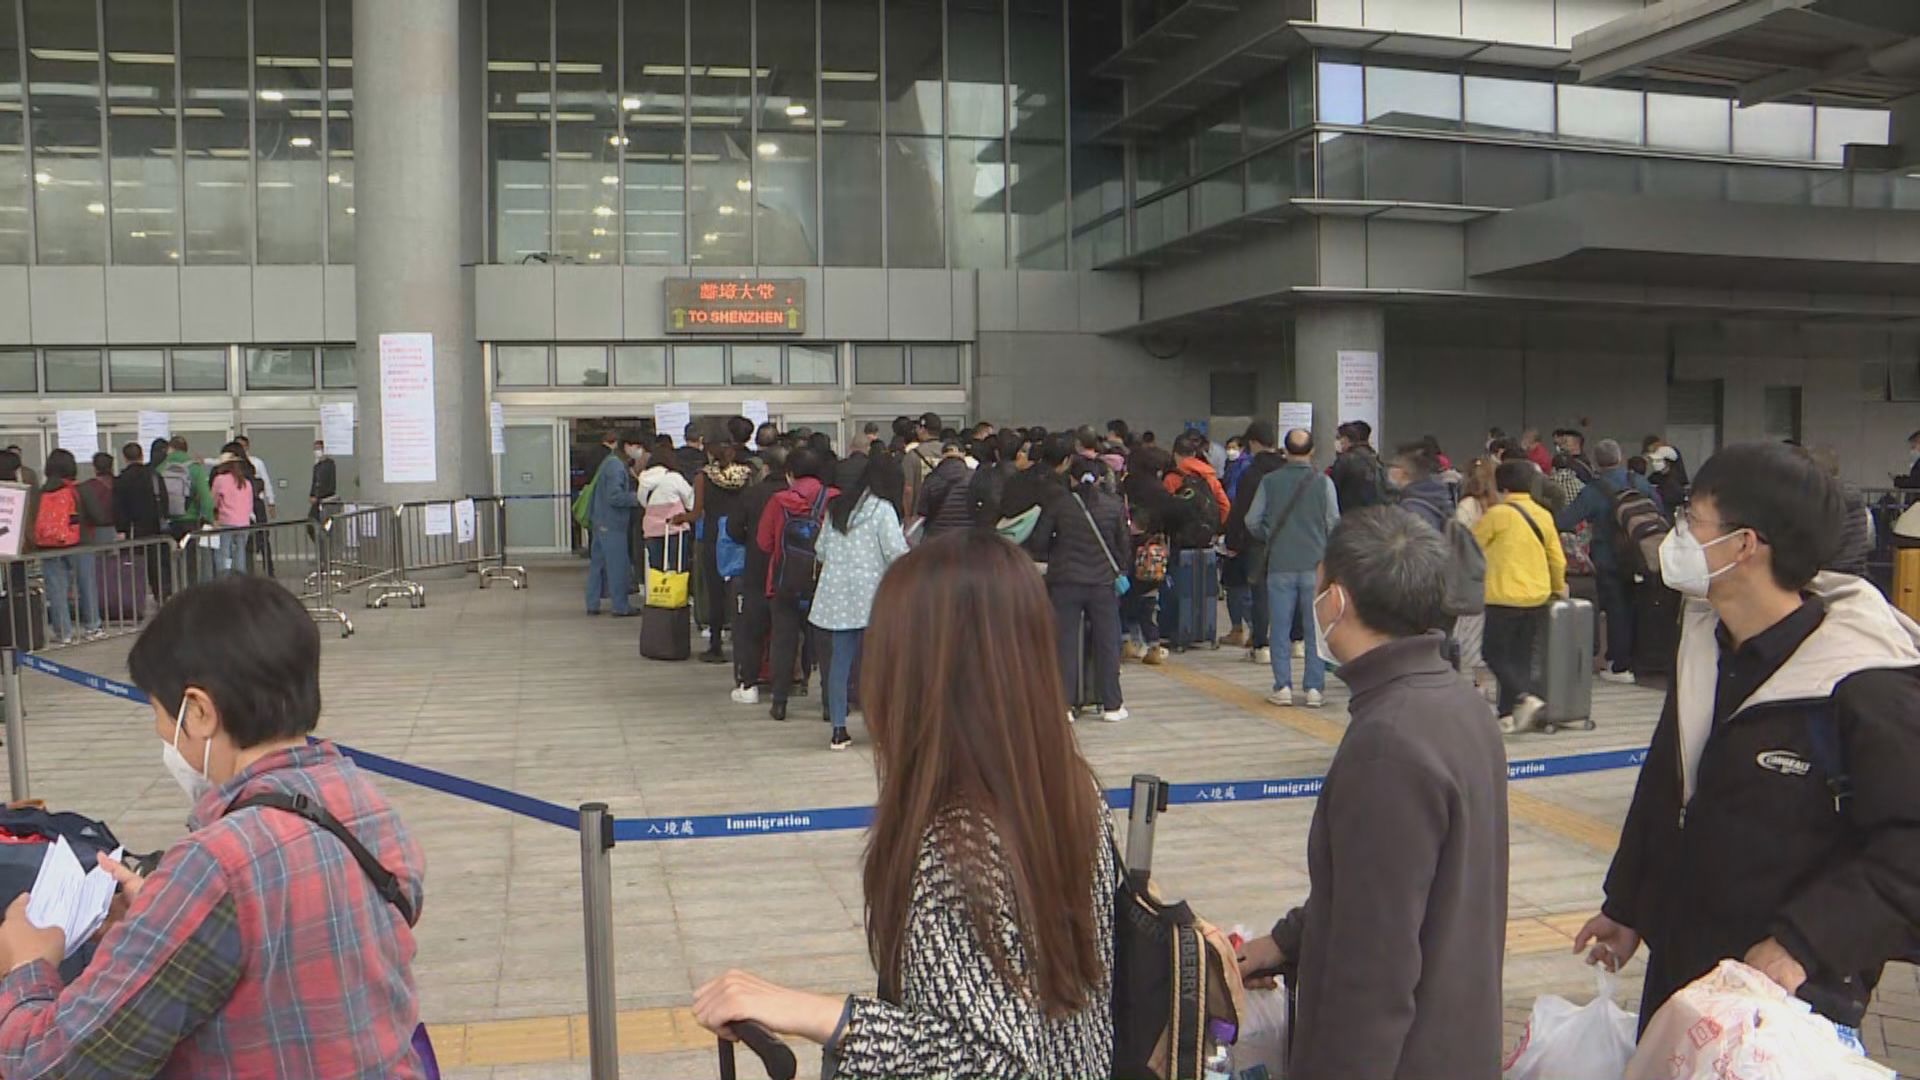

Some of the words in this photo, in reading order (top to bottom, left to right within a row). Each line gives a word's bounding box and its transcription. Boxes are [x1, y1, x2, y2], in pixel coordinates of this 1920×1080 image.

[688, 310, 707, 323] TO
[710, 310, 784, 323] SHENZHEN
[647, 820, 695, 836] 入境處
[726, 814, 811, 831] Immigration
